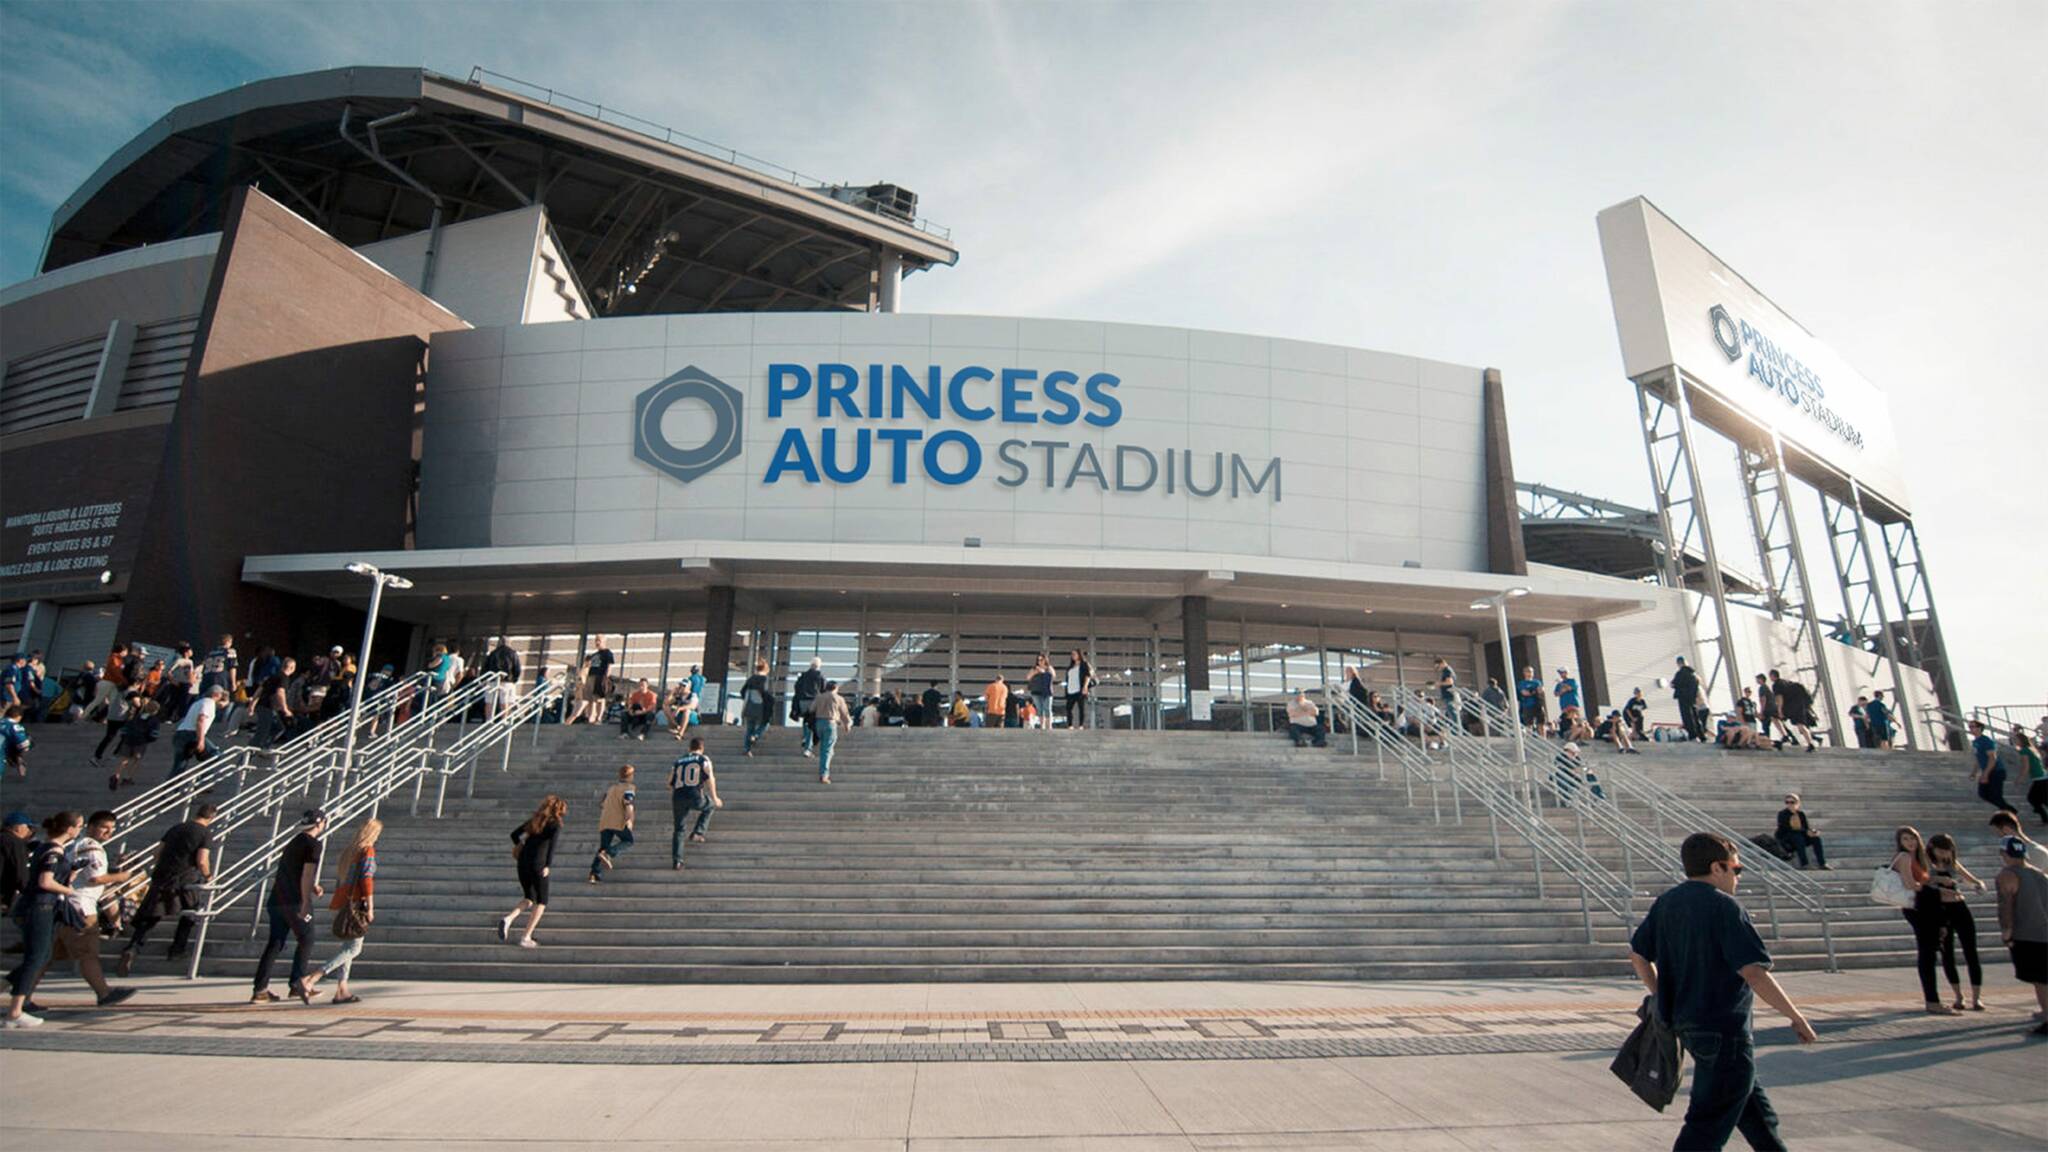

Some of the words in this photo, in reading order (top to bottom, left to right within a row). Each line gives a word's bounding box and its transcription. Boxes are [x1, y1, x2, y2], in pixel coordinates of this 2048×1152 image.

[1740, 319, 1824, 399] PRINCESS
[766, 362, 1123, 428] PRINCESS
[1749, 352, 1799, 405] AUTO
[1801, 391, 1864, 449] STADIUM
[763, 427, 982, 486] AUTO
[996, 438, 1282, 502] STADIUM
[42, 509, 70, 522] LIQUOR
[70, 507, 78, 519] &
[79, 503, 122, 516] LOTTERIES
[32, 524, 54, 536] SUITE
[54, 520, 91, 533] HOLDERS
[27, 543, 52, 555] EVENT
[52, 540, 80, 552] SUITES
[92, 536, 100, 548] &
[23, 562, 43, 574] CLUB
[43, 560, 51, 572] &
[51, 560, 72, 571] LOGE
[72, 556, 109, 568] SEATING
[675, 763, 700, 789] 10
